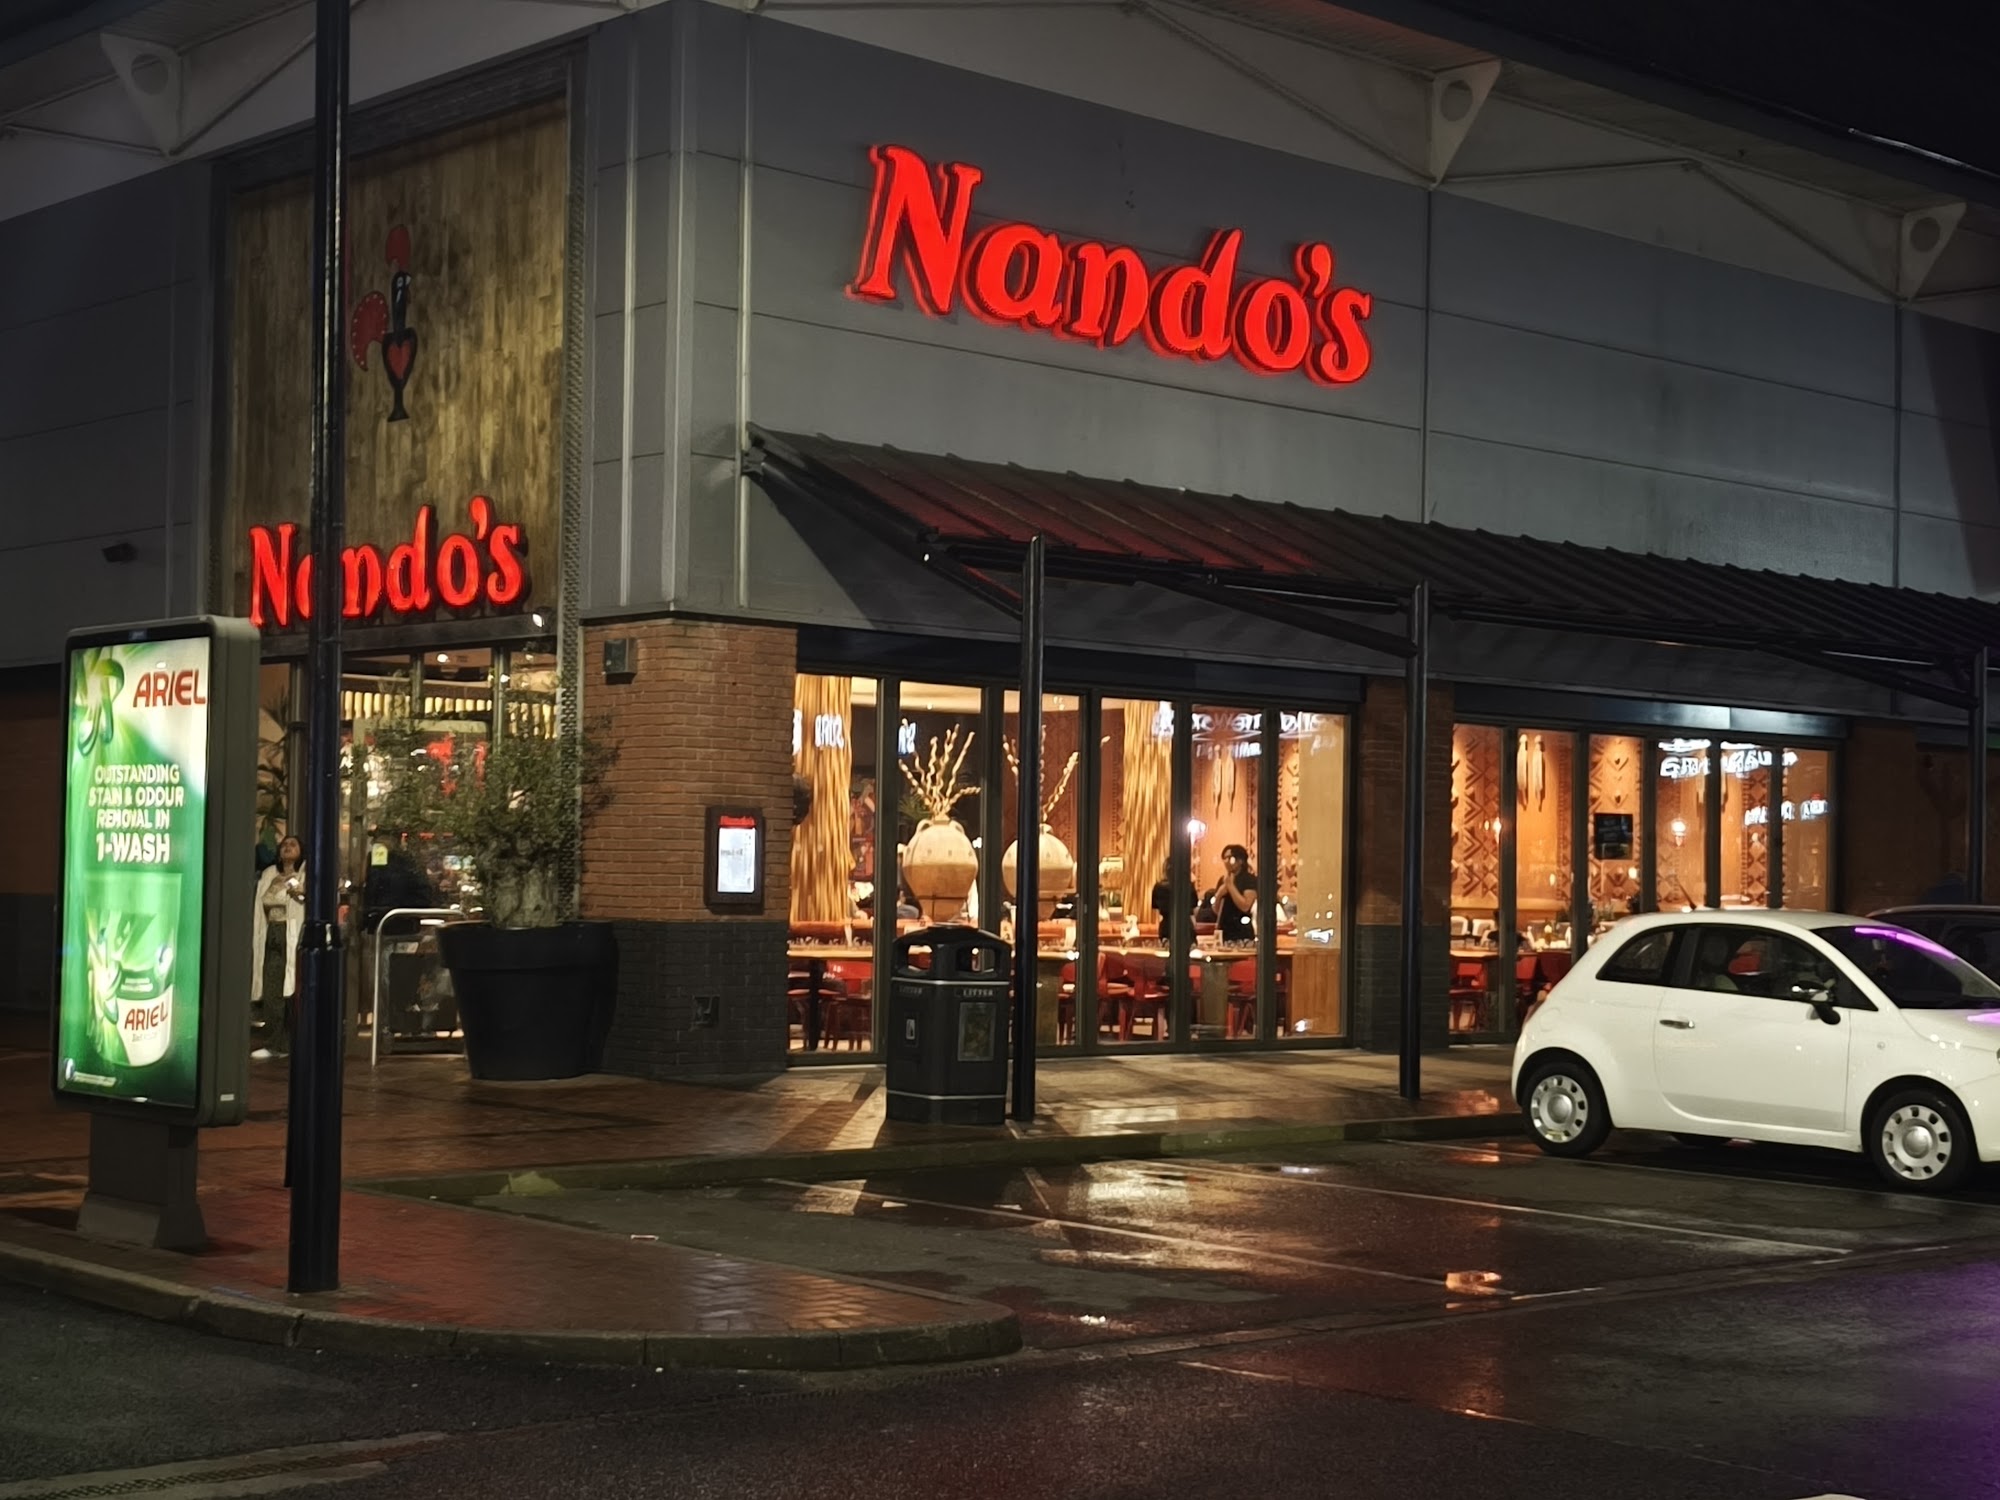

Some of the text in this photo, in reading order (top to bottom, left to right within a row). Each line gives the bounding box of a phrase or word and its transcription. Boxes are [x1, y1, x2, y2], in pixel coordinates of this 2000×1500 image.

[845, 143, 1374, 388] Nando's
[133, 669, 206, 708] ARIEL
[94, 763, 180, 784] OUTSTANDING
[135, 786, 184, 808] ODOUR
[96, 808, 170, 830] REMOVAL IN
[95, 832, 171, 864] 1-WASH
[963, 988, 993, 997] LITTER
[124, 1001, 168, 1031] ARIEL
